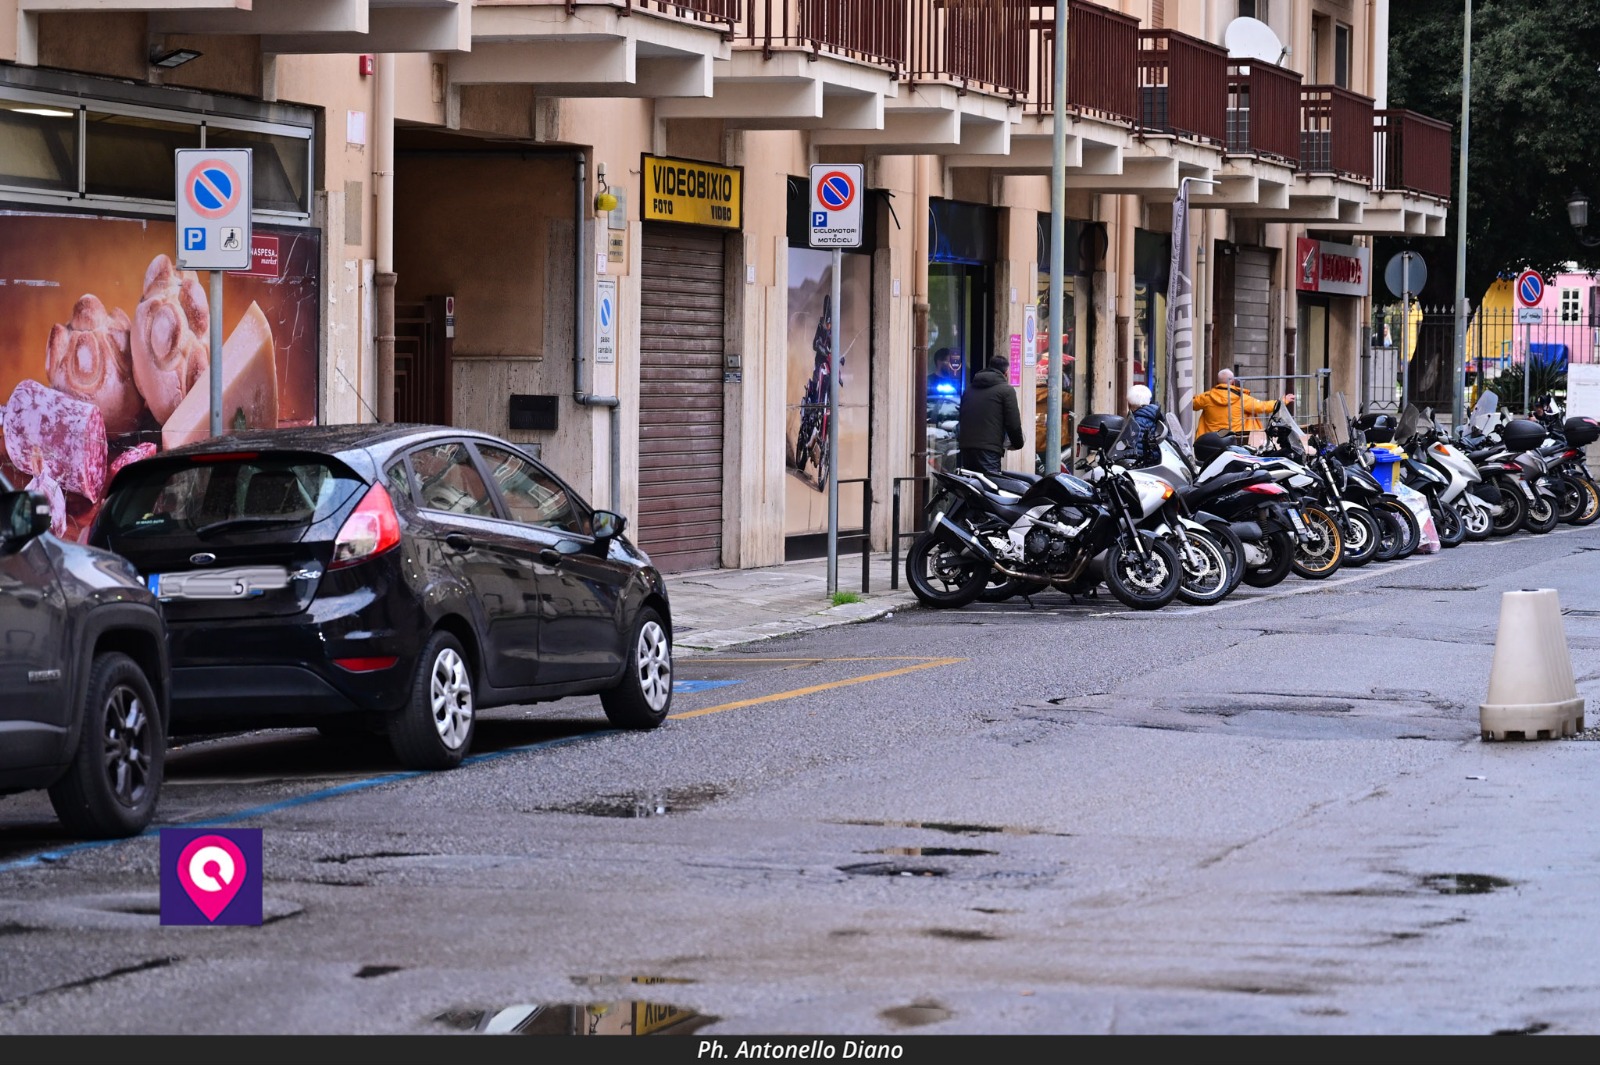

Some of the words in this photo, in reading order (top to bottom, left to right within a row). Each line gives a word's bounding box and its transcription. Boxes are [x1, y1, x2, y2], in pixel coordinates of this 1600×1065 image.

[653, 165, 732, 202] VIDEOBIXIO
[653, 198, 673, 215] FOTO
[711, 205, 732, 221] VIDEO
[816, 214, 824, 225] P
[188, 230, 202, 249] P
[1321, 252, 1362, 285] HONDA
